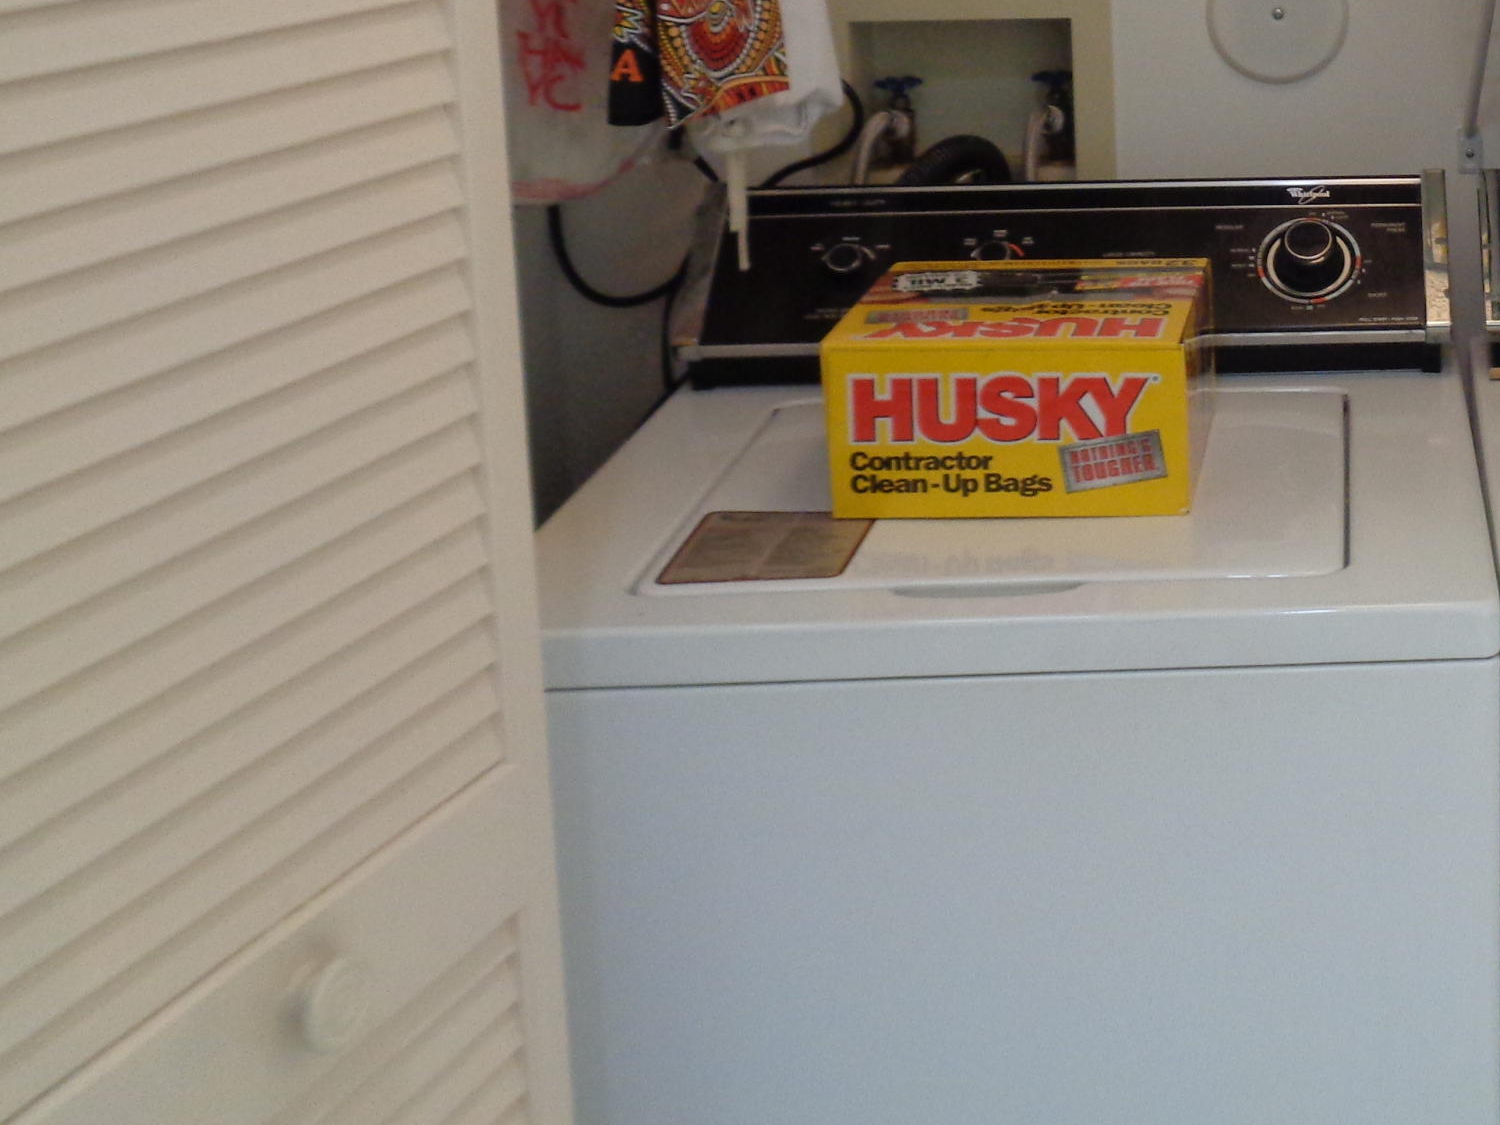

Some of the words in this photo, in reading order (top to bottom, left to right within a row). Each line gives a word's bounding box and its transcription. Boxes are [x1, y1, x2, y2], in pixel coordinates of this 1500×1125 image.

[610, 49, 643, 82] A
[863, 317, 1168, 339] HUSKY
[850, 374, 1150, 443] HUSKY
[850, 451, 993, 472] Contractor
[1073, 454, 1158, 484] TOUGHER
[985, 474, 1053, 497] Bags
